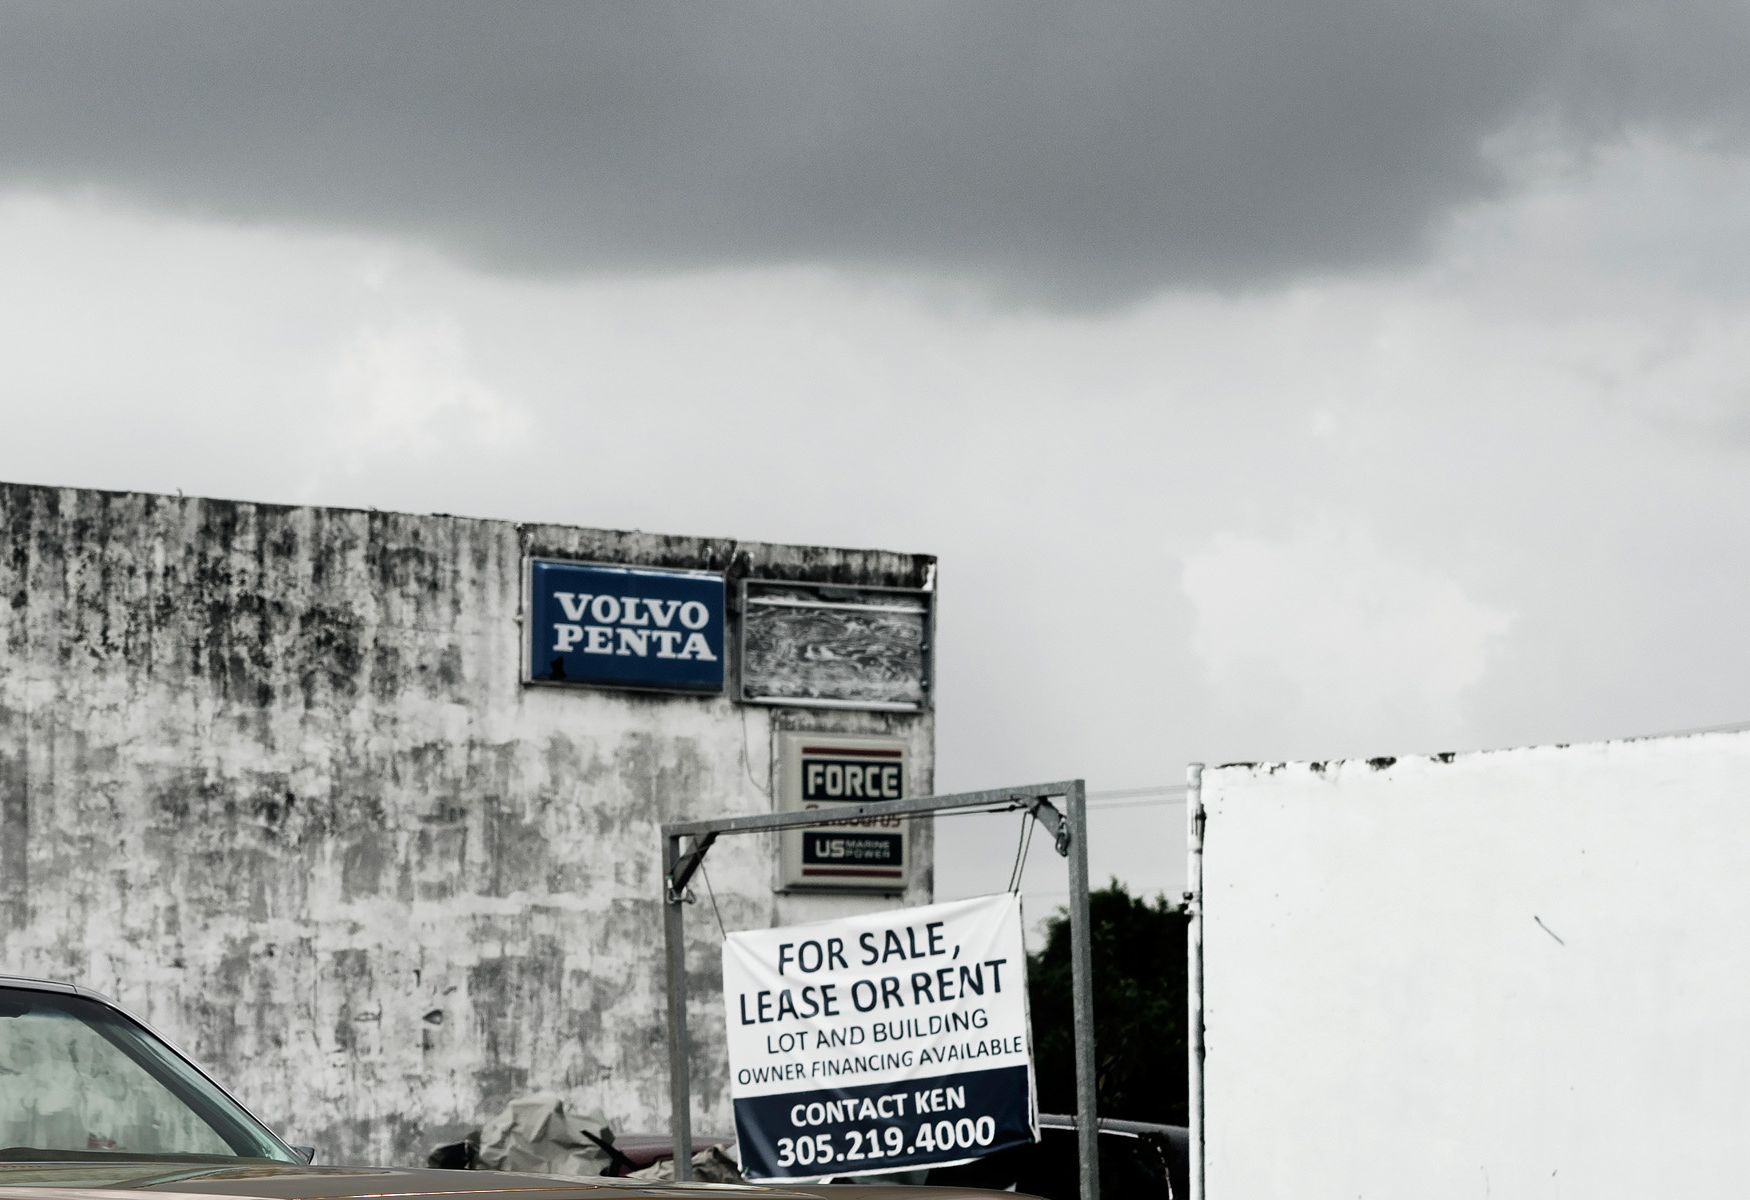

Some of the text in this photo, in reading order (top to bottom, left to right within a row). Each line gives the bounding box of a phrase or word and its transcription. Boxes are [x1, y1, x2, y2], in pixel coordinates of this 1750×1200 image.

[553, 592, 710, 631] VOLVO
[553, 623, 718, 661] PENTA
[807, 763, 900, 798] FORCE
[815, 839, 846, 858] US
[778, 921, 961, 976] FOR SALE,
[739, 958, 1008, 1026] LEASE OR RENT
[766, 1008, 989, 1055] LOT AND BUILDING
[737, 1035, 1023, 1086] OWNER FINANCING AVAILABLE
[790, 1085, 966, 1128] CONTACT KEN
[776, 1115, 996, 1168] 305.219.4000
